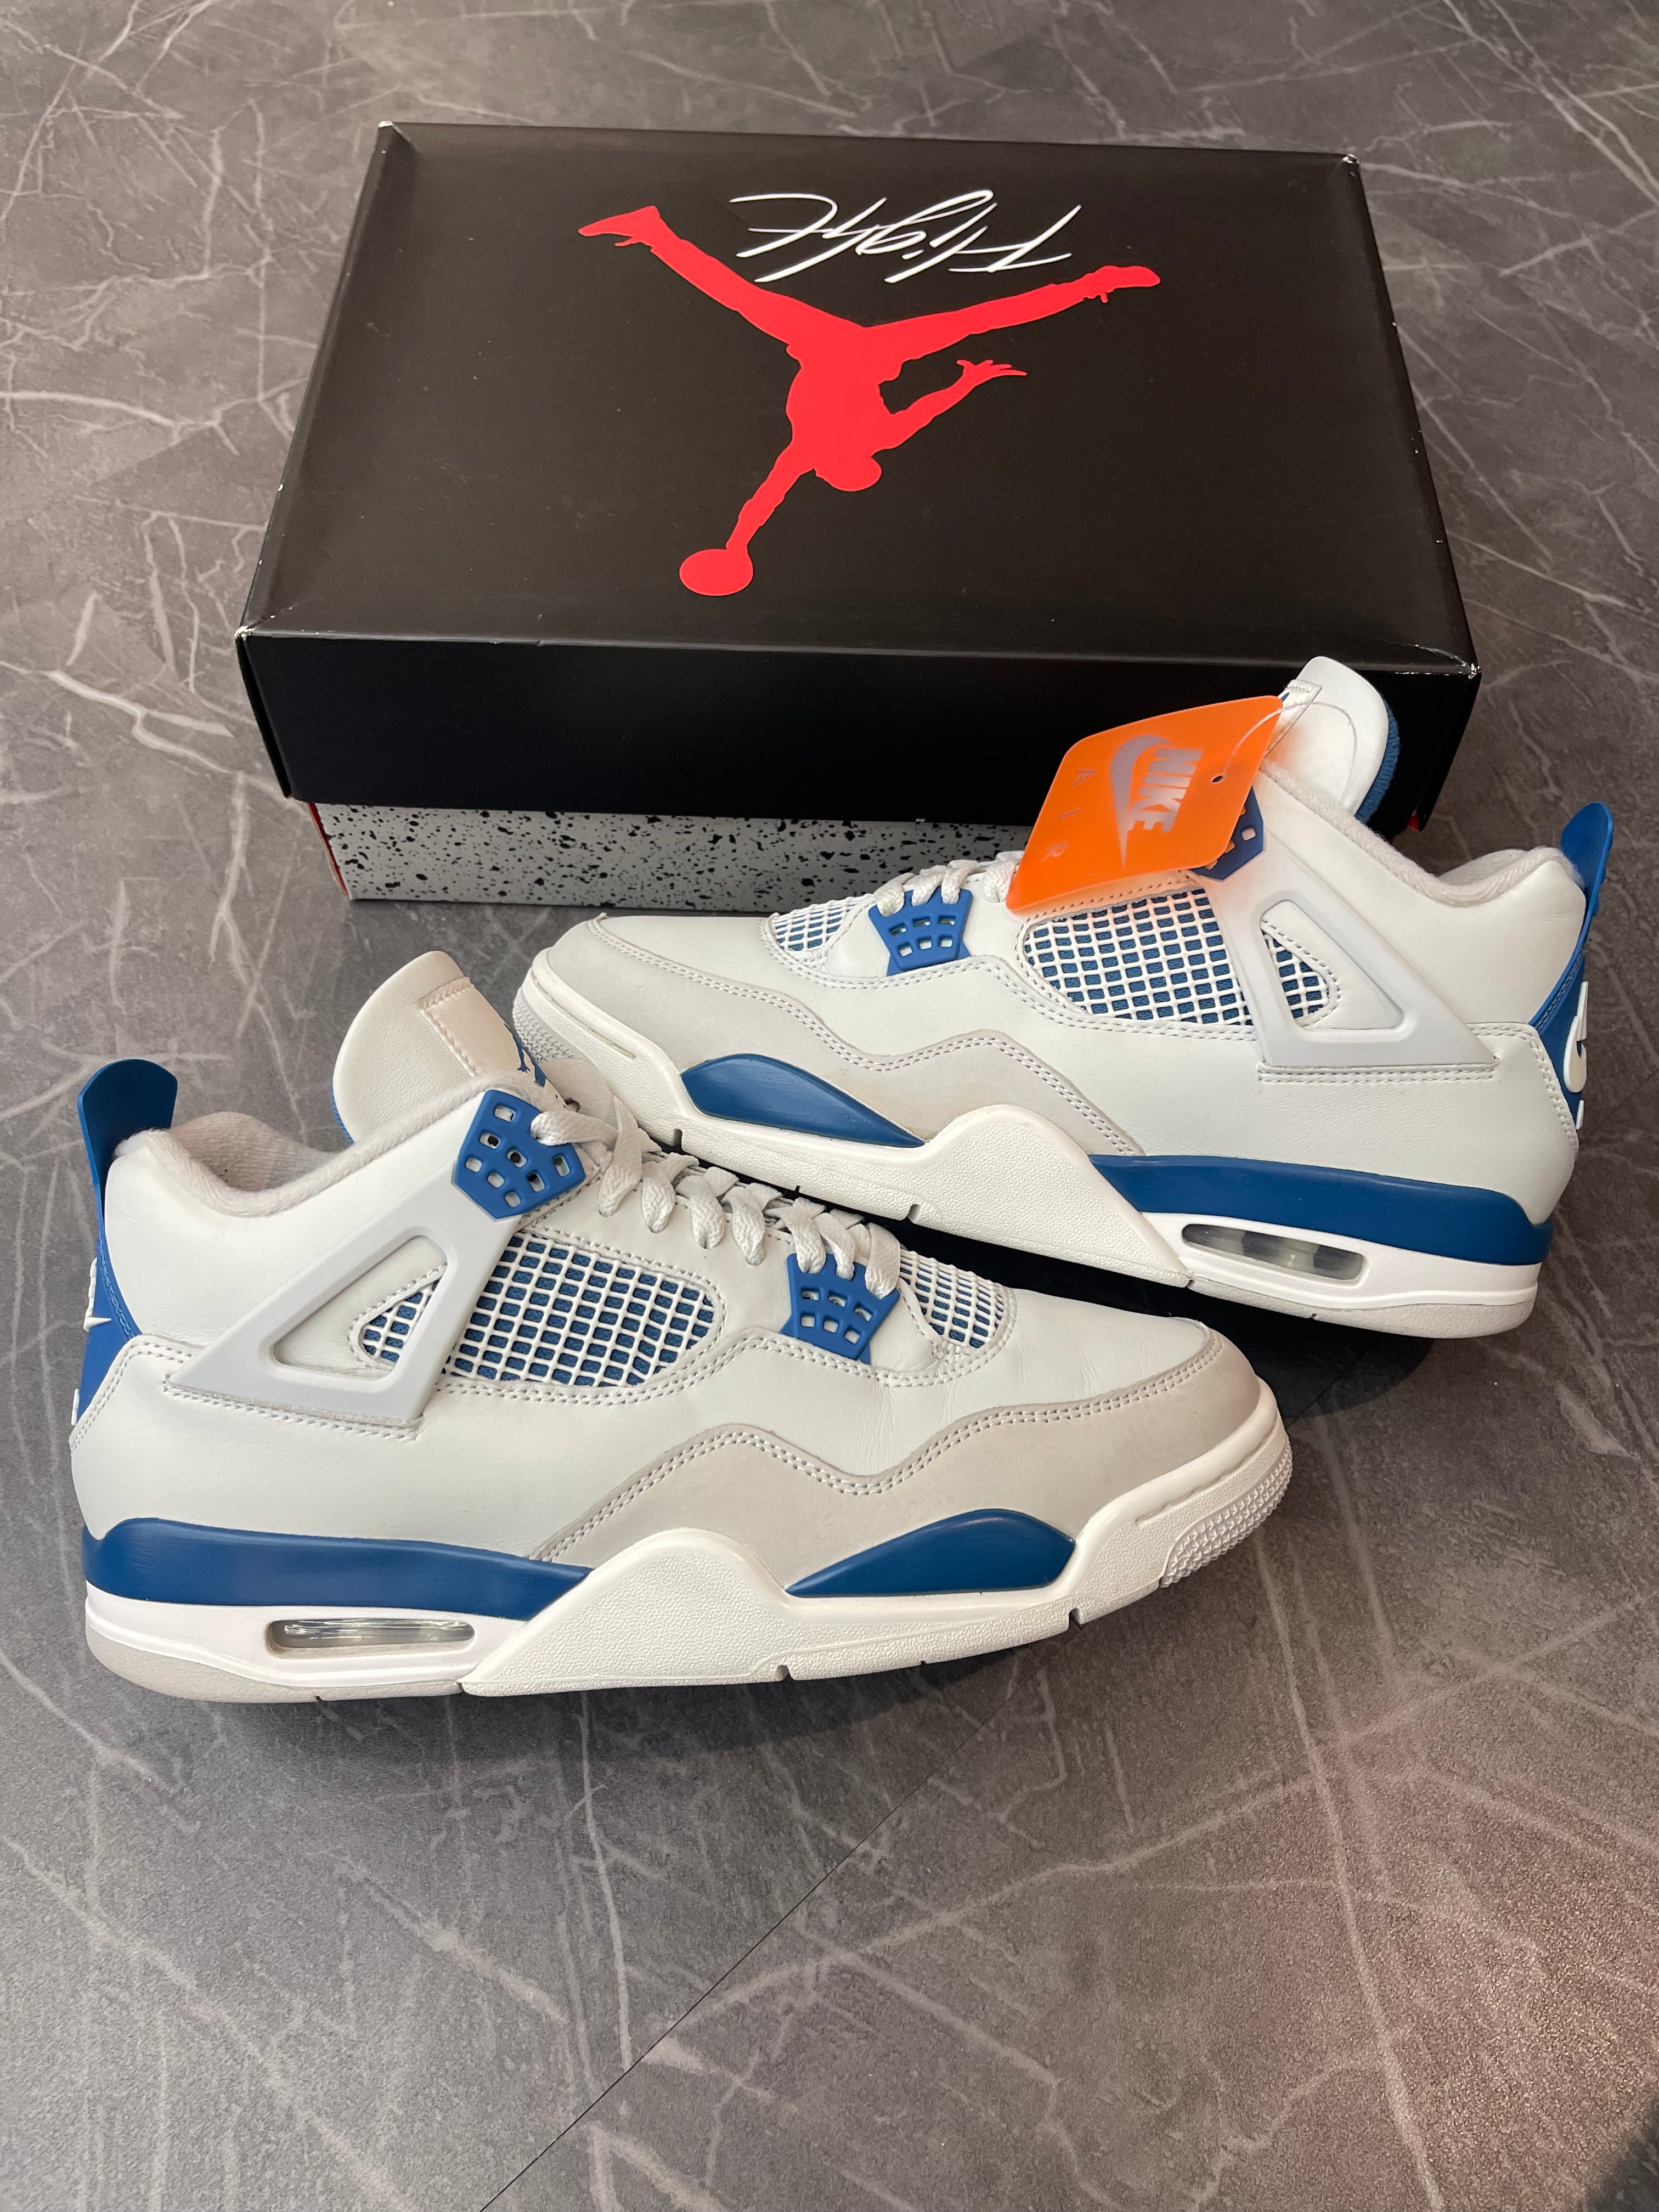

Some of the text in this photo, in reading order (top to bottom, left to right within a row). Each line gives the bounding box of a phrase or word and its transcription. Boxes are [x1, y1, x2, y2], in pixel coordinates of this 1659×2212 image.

[729, 189, 1082, 284] Flight
[1040, 769, 1098, 863] AIR
[1127, 747, 1203, 832] NIKE
